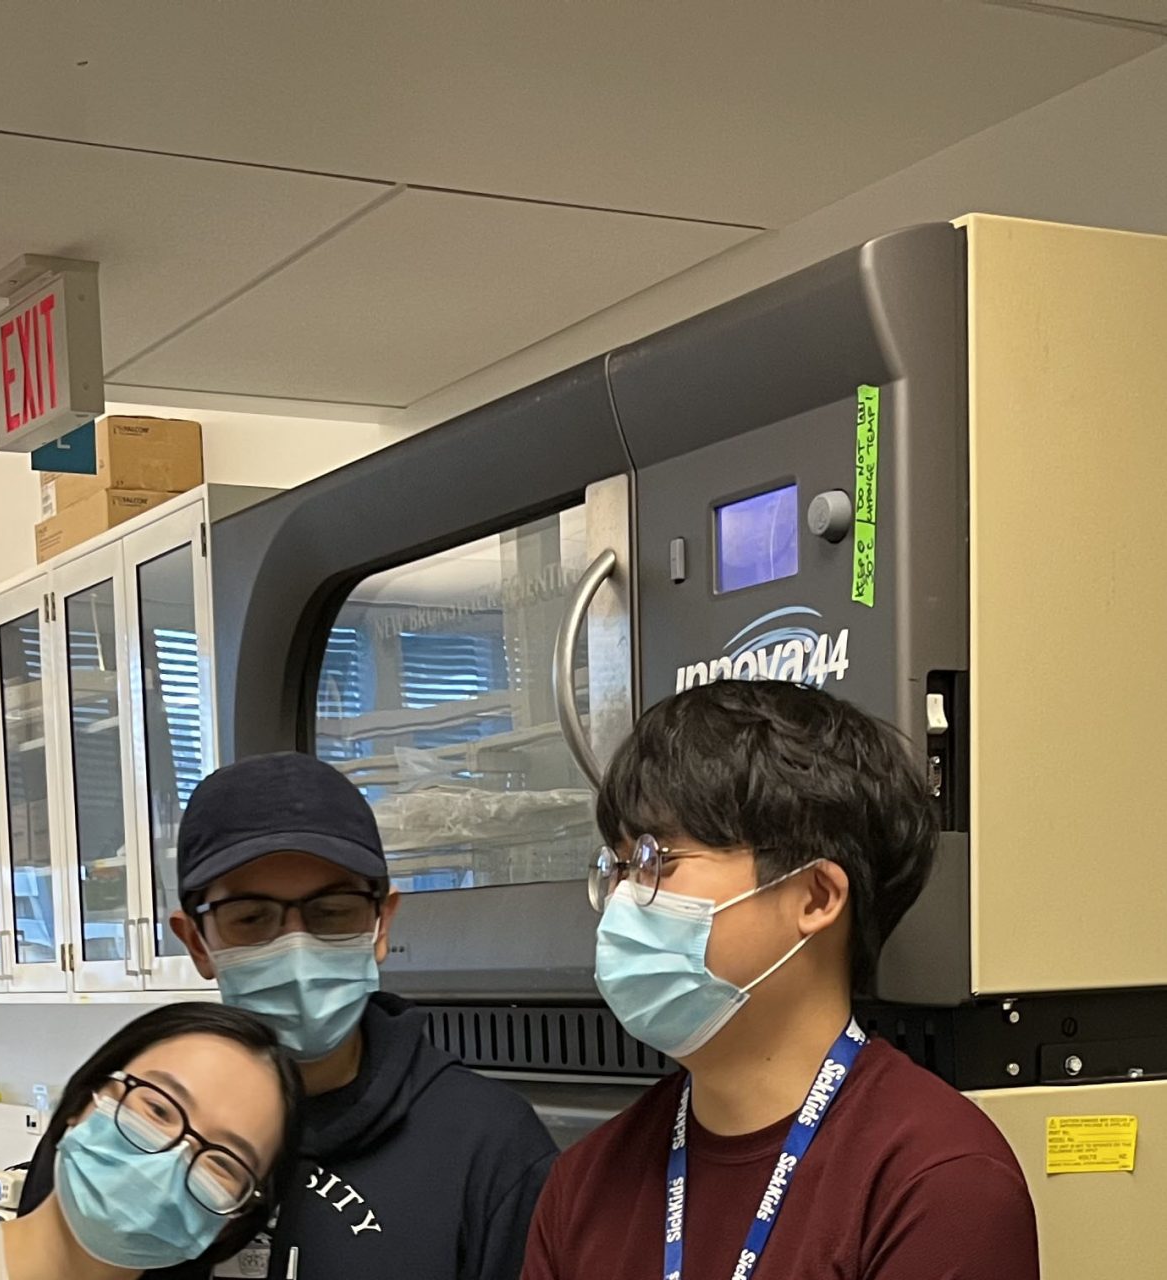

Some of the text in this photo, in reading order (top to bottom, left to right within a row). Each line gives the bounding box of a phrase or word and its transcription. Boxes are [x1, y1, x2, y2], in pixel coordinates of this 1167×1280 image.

[0, 294, 57, 433] EXIT
[856, 439, 865, 513] DO NOT
[797, 1058, 846, 1127] SickKids
[667, 1176, 684, 1243] SickKids
[756, 1152, 798, 1222] SickKids
